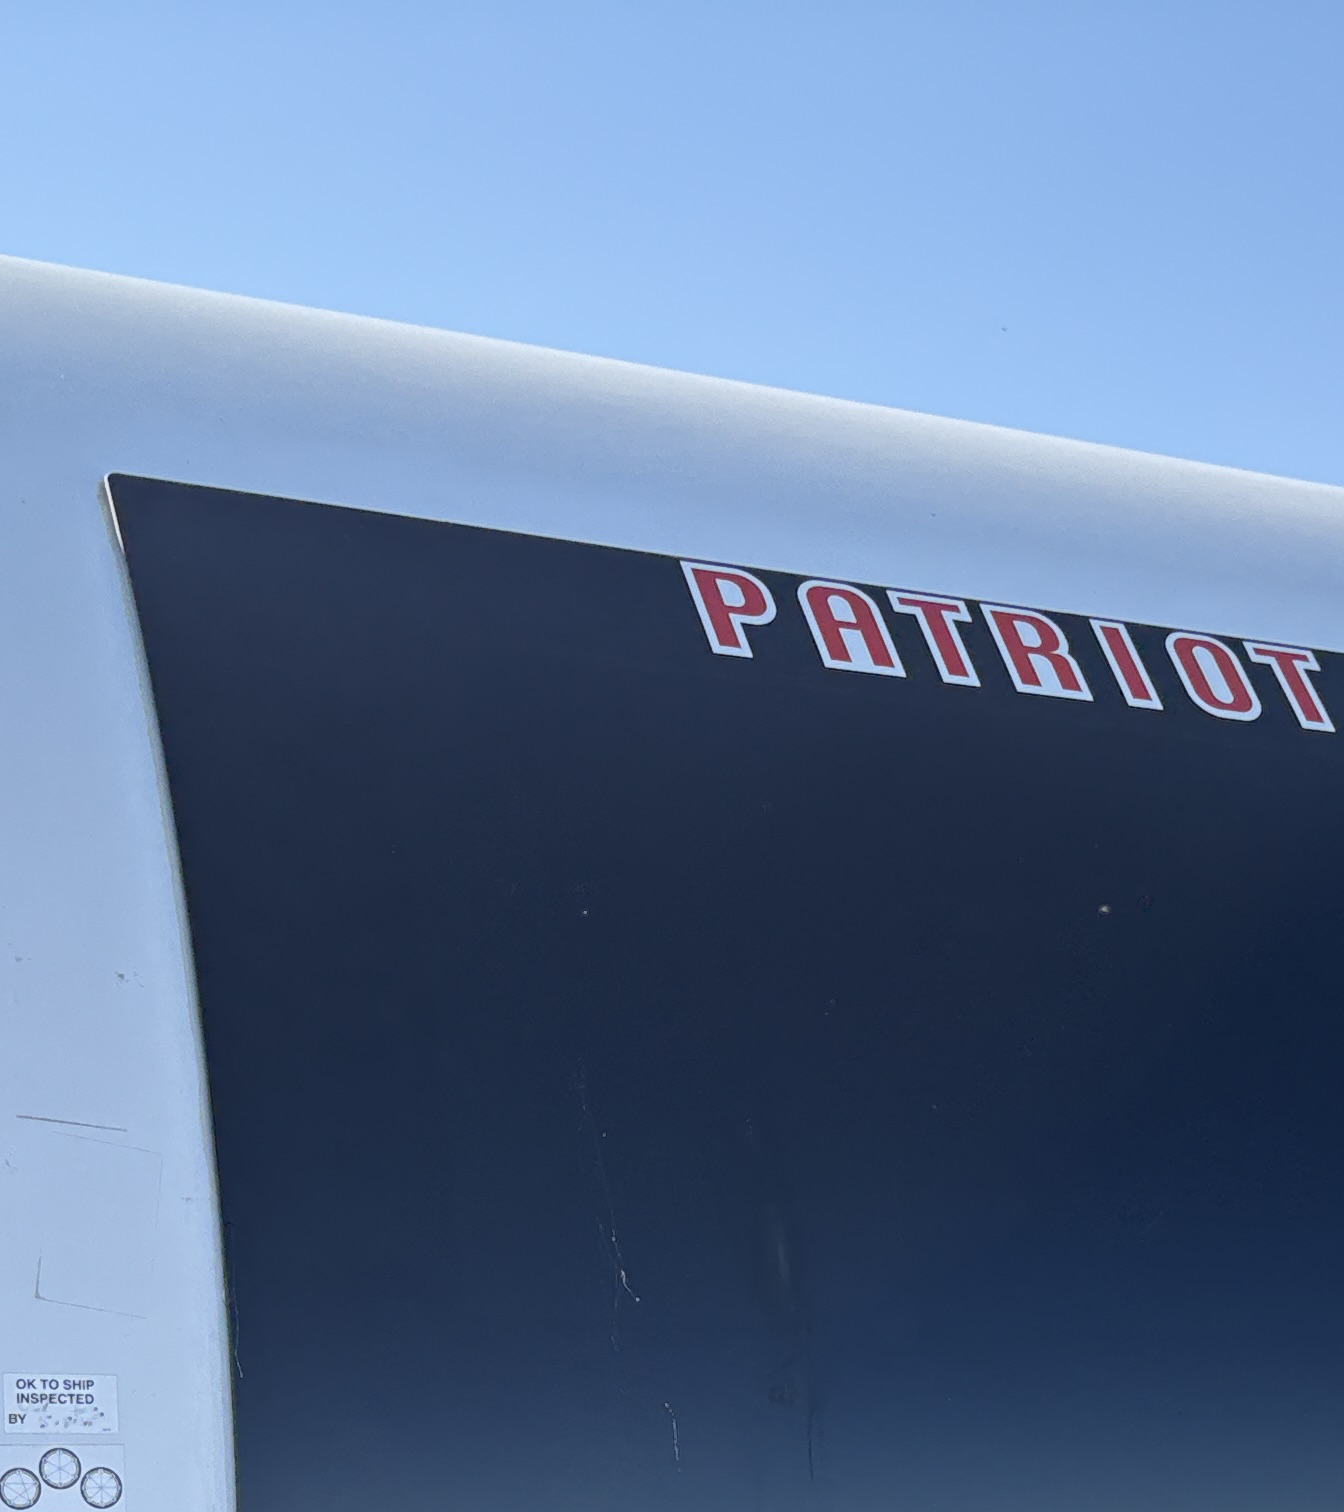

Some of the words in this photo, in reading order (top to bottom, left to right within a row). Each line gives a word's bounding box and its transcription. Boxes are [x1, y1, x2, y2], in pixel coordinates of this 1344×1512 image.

[680, 560, 1336, 732] PATRIOT
[15, 1378, 37, 1390] OK
[40, 1379, 59, 1391] TO
[62, 1379, 95, 1391] SHIP
[16, 1393, 95, 1405] INSPECTED
[8, 1413, 26, 1425] BY
